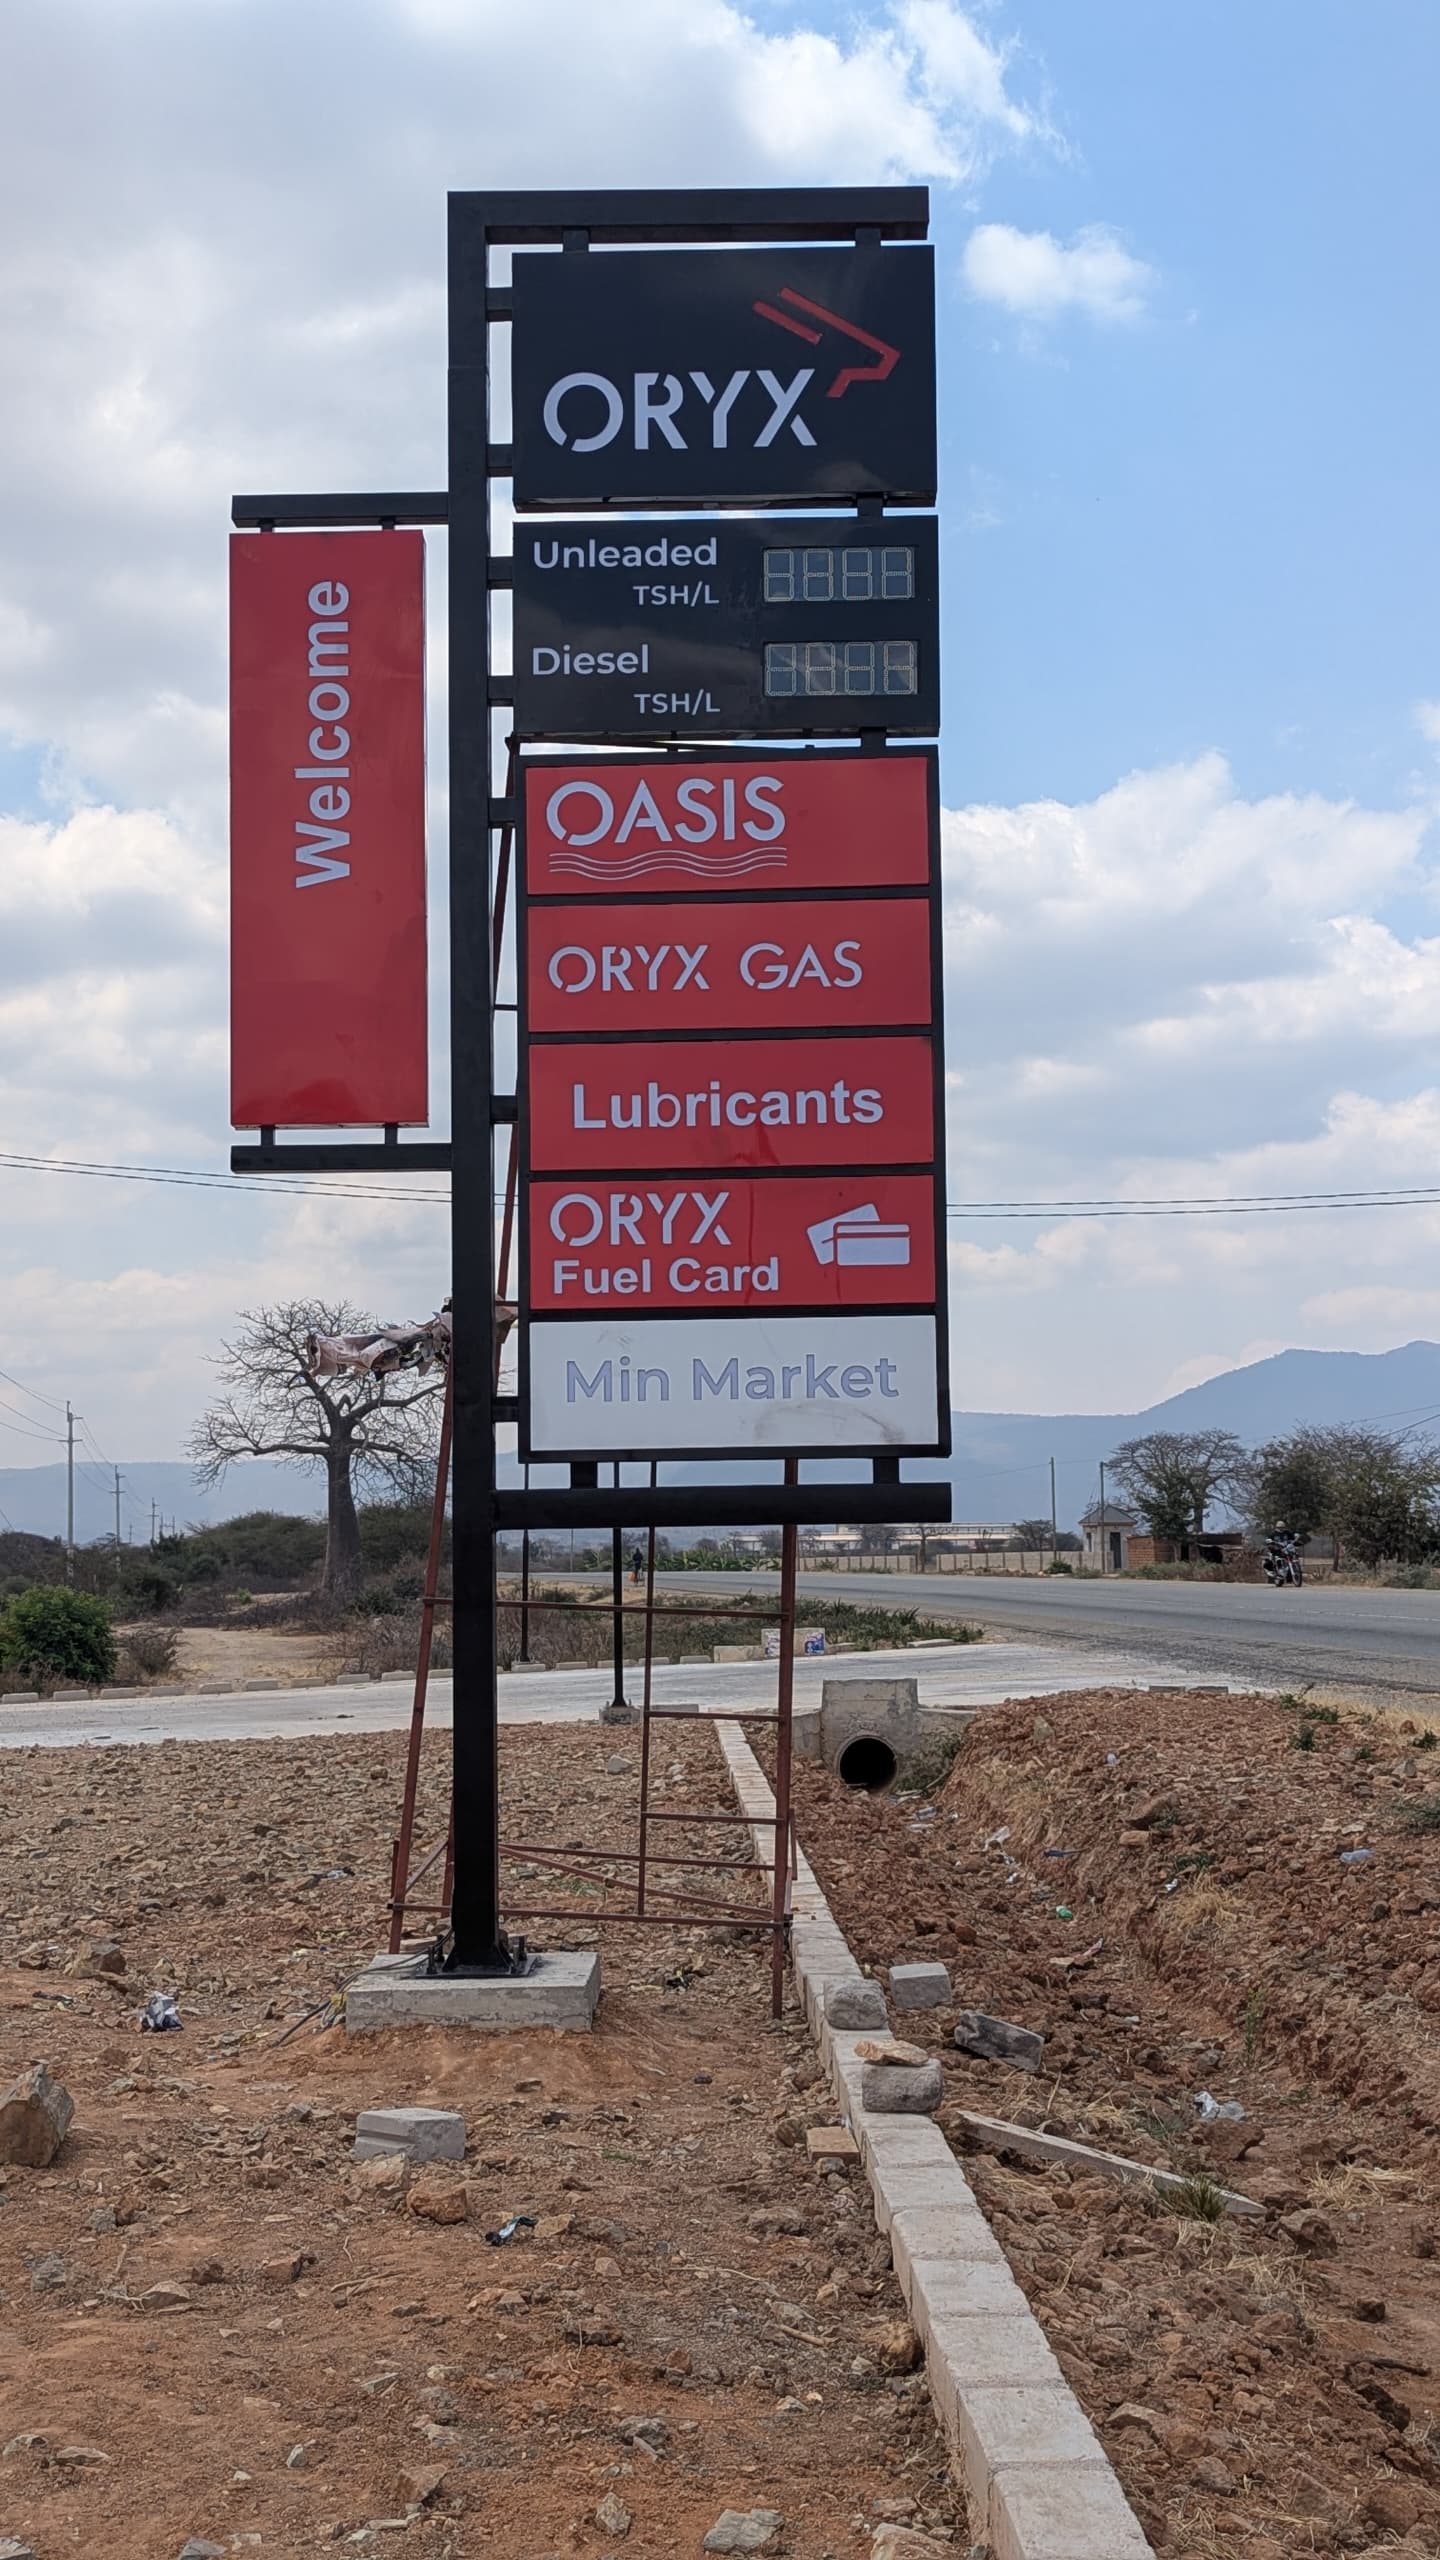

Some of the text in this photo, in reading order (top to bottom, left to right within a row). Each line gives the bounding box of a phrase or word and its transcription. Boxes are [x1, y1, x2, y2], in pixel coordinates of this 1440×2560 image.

[542, 368, 818, 453] ORYX
[532, 537, 719, 569] Unleaded
[633, 580, 720, 608] TSH/L
[531, 643, 650, 676] Diesel
[634, 688, 721, 718] TSH/L
[294, 580, 351, 889] Welcome
[545, 776, 787, 847] OASIS
[548, 940, 864, 993] ORYX GAS
[572, 1079, 885, 1129] Lubricants
[549, 1191, 732, 1247] ORYX
[552, 1256, 780, 1295] Fuel Card
[565, 1353, 900, 1403] Min Market
